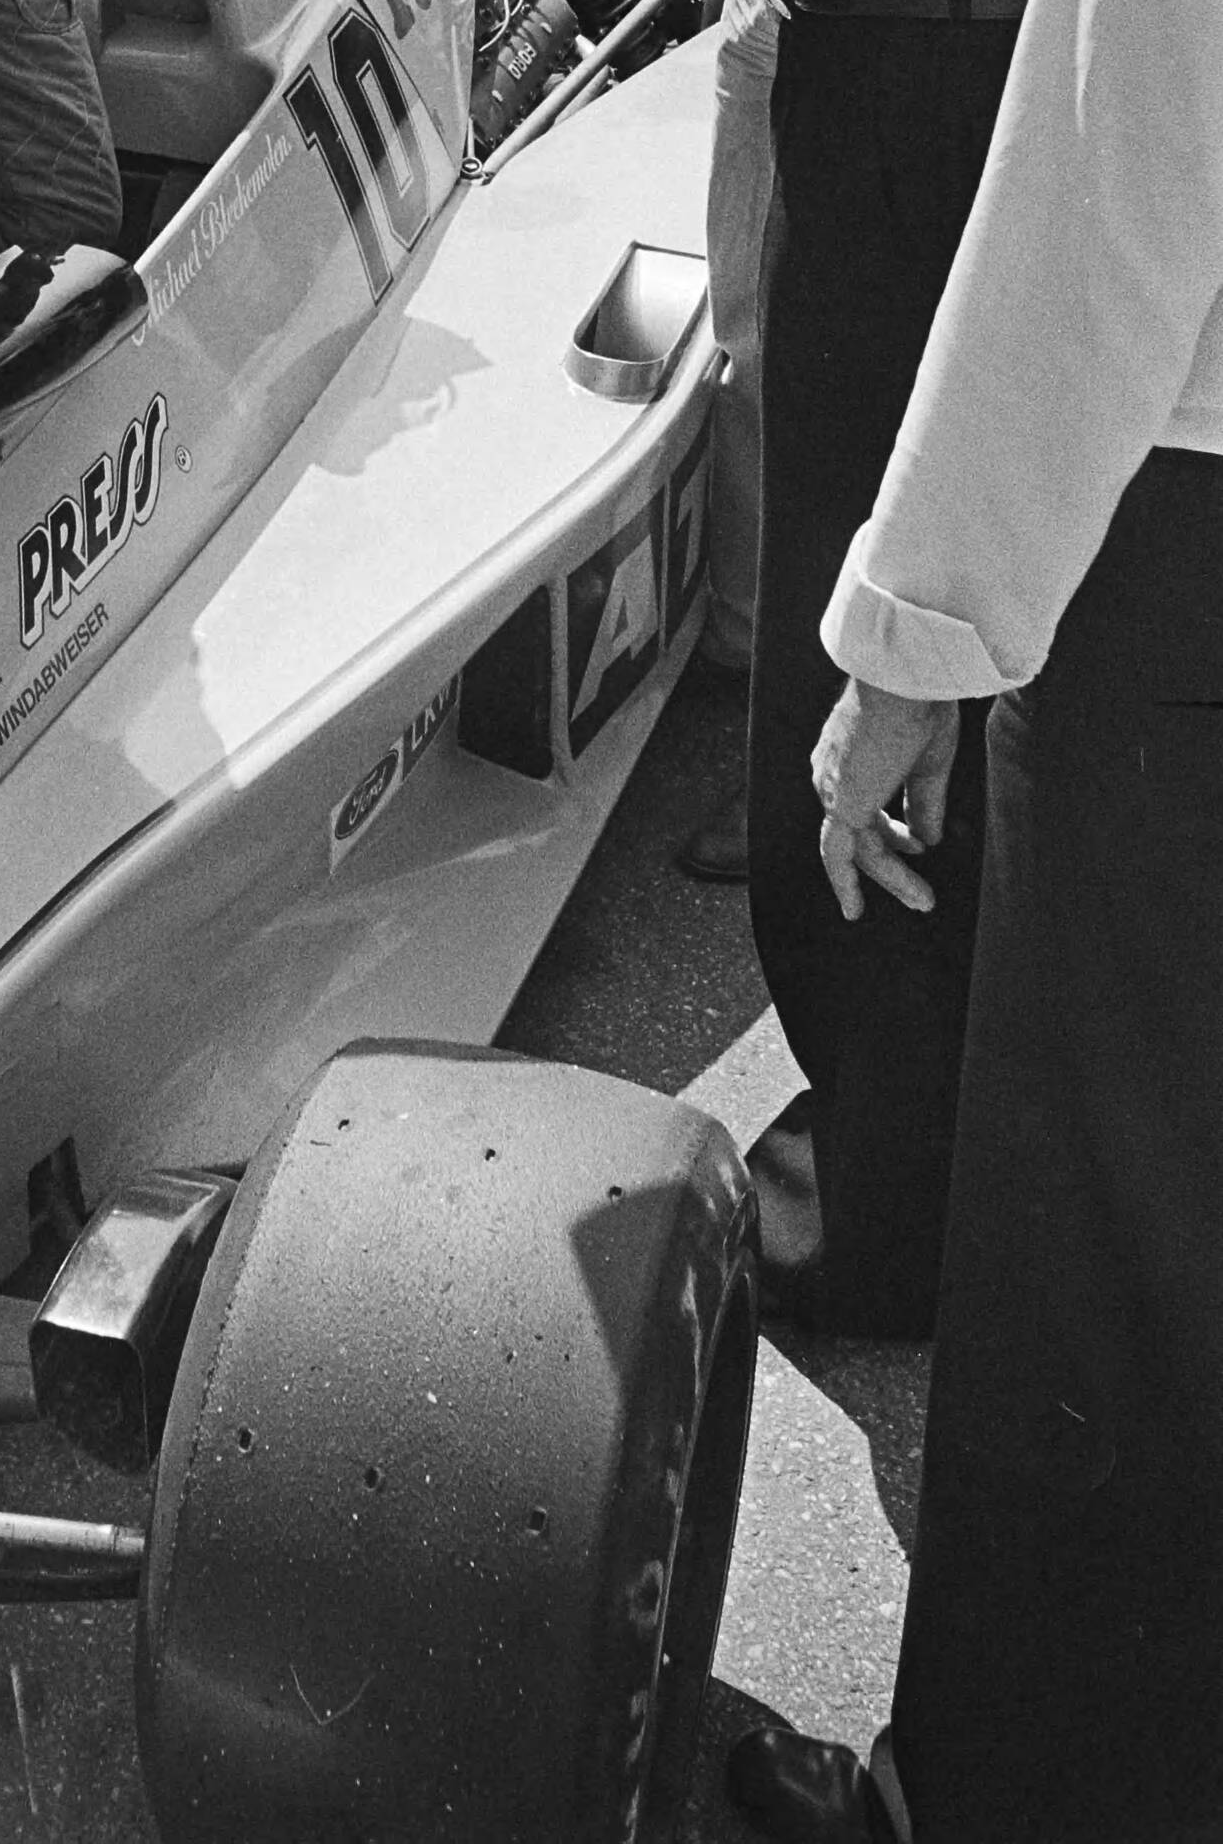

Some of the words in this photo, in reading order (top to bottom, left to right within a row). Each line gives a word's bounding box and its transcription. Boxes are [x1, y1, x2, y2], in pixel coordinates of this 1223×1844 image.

[283, 8, 431, 306] 10
[507, 41, 538, 80] FORD
[18, 392, 169, 649] PRESS
